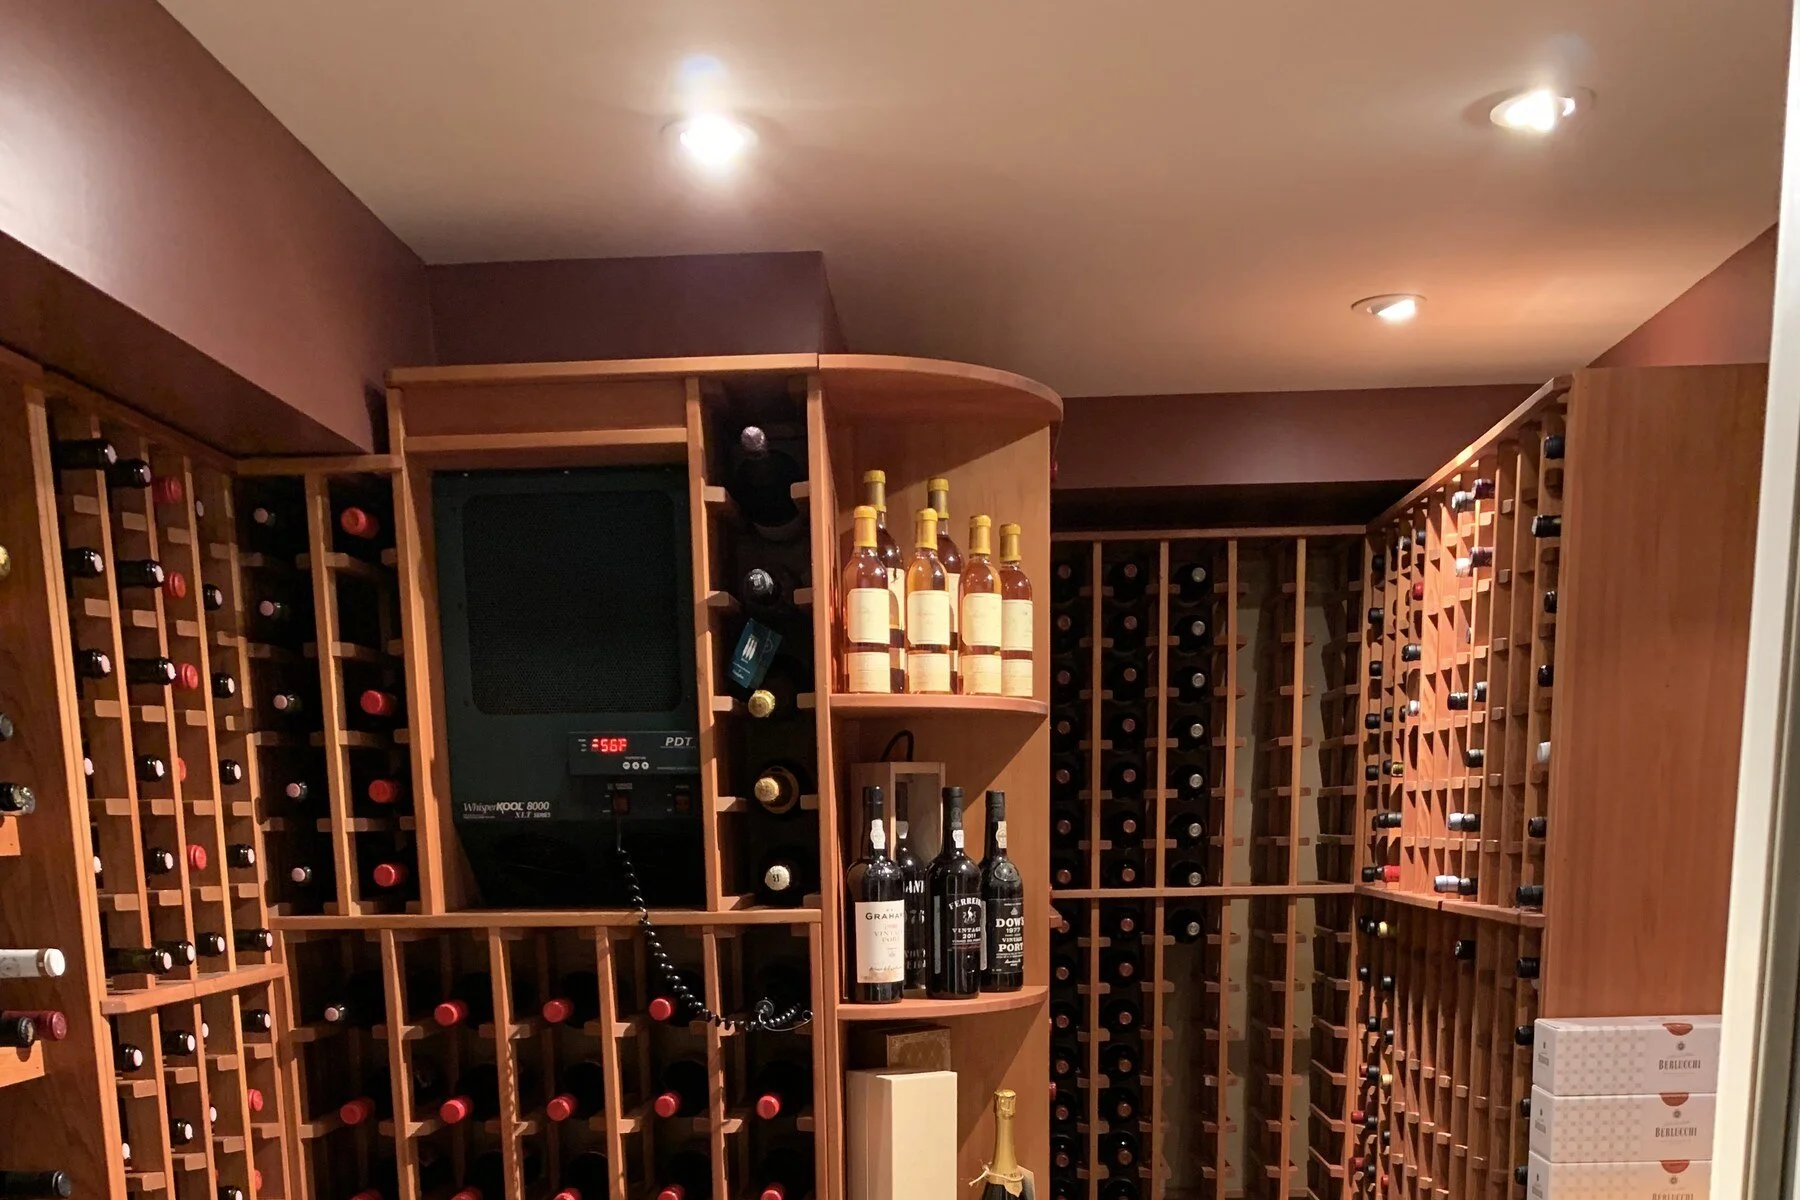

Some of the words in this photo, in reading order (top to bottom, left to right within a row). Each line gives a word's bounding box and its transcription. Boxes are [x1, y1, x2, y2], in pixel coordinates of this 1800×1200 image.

[665, 736, 693, 747] PDT
[526, 801, 550, 811] 8000
[515, 811, 531, 819] XLT
[1658, 1059, 1701, 1071] BERLUCCHI
[1655, 1126, 1698, 1138] BERLUCCHI
